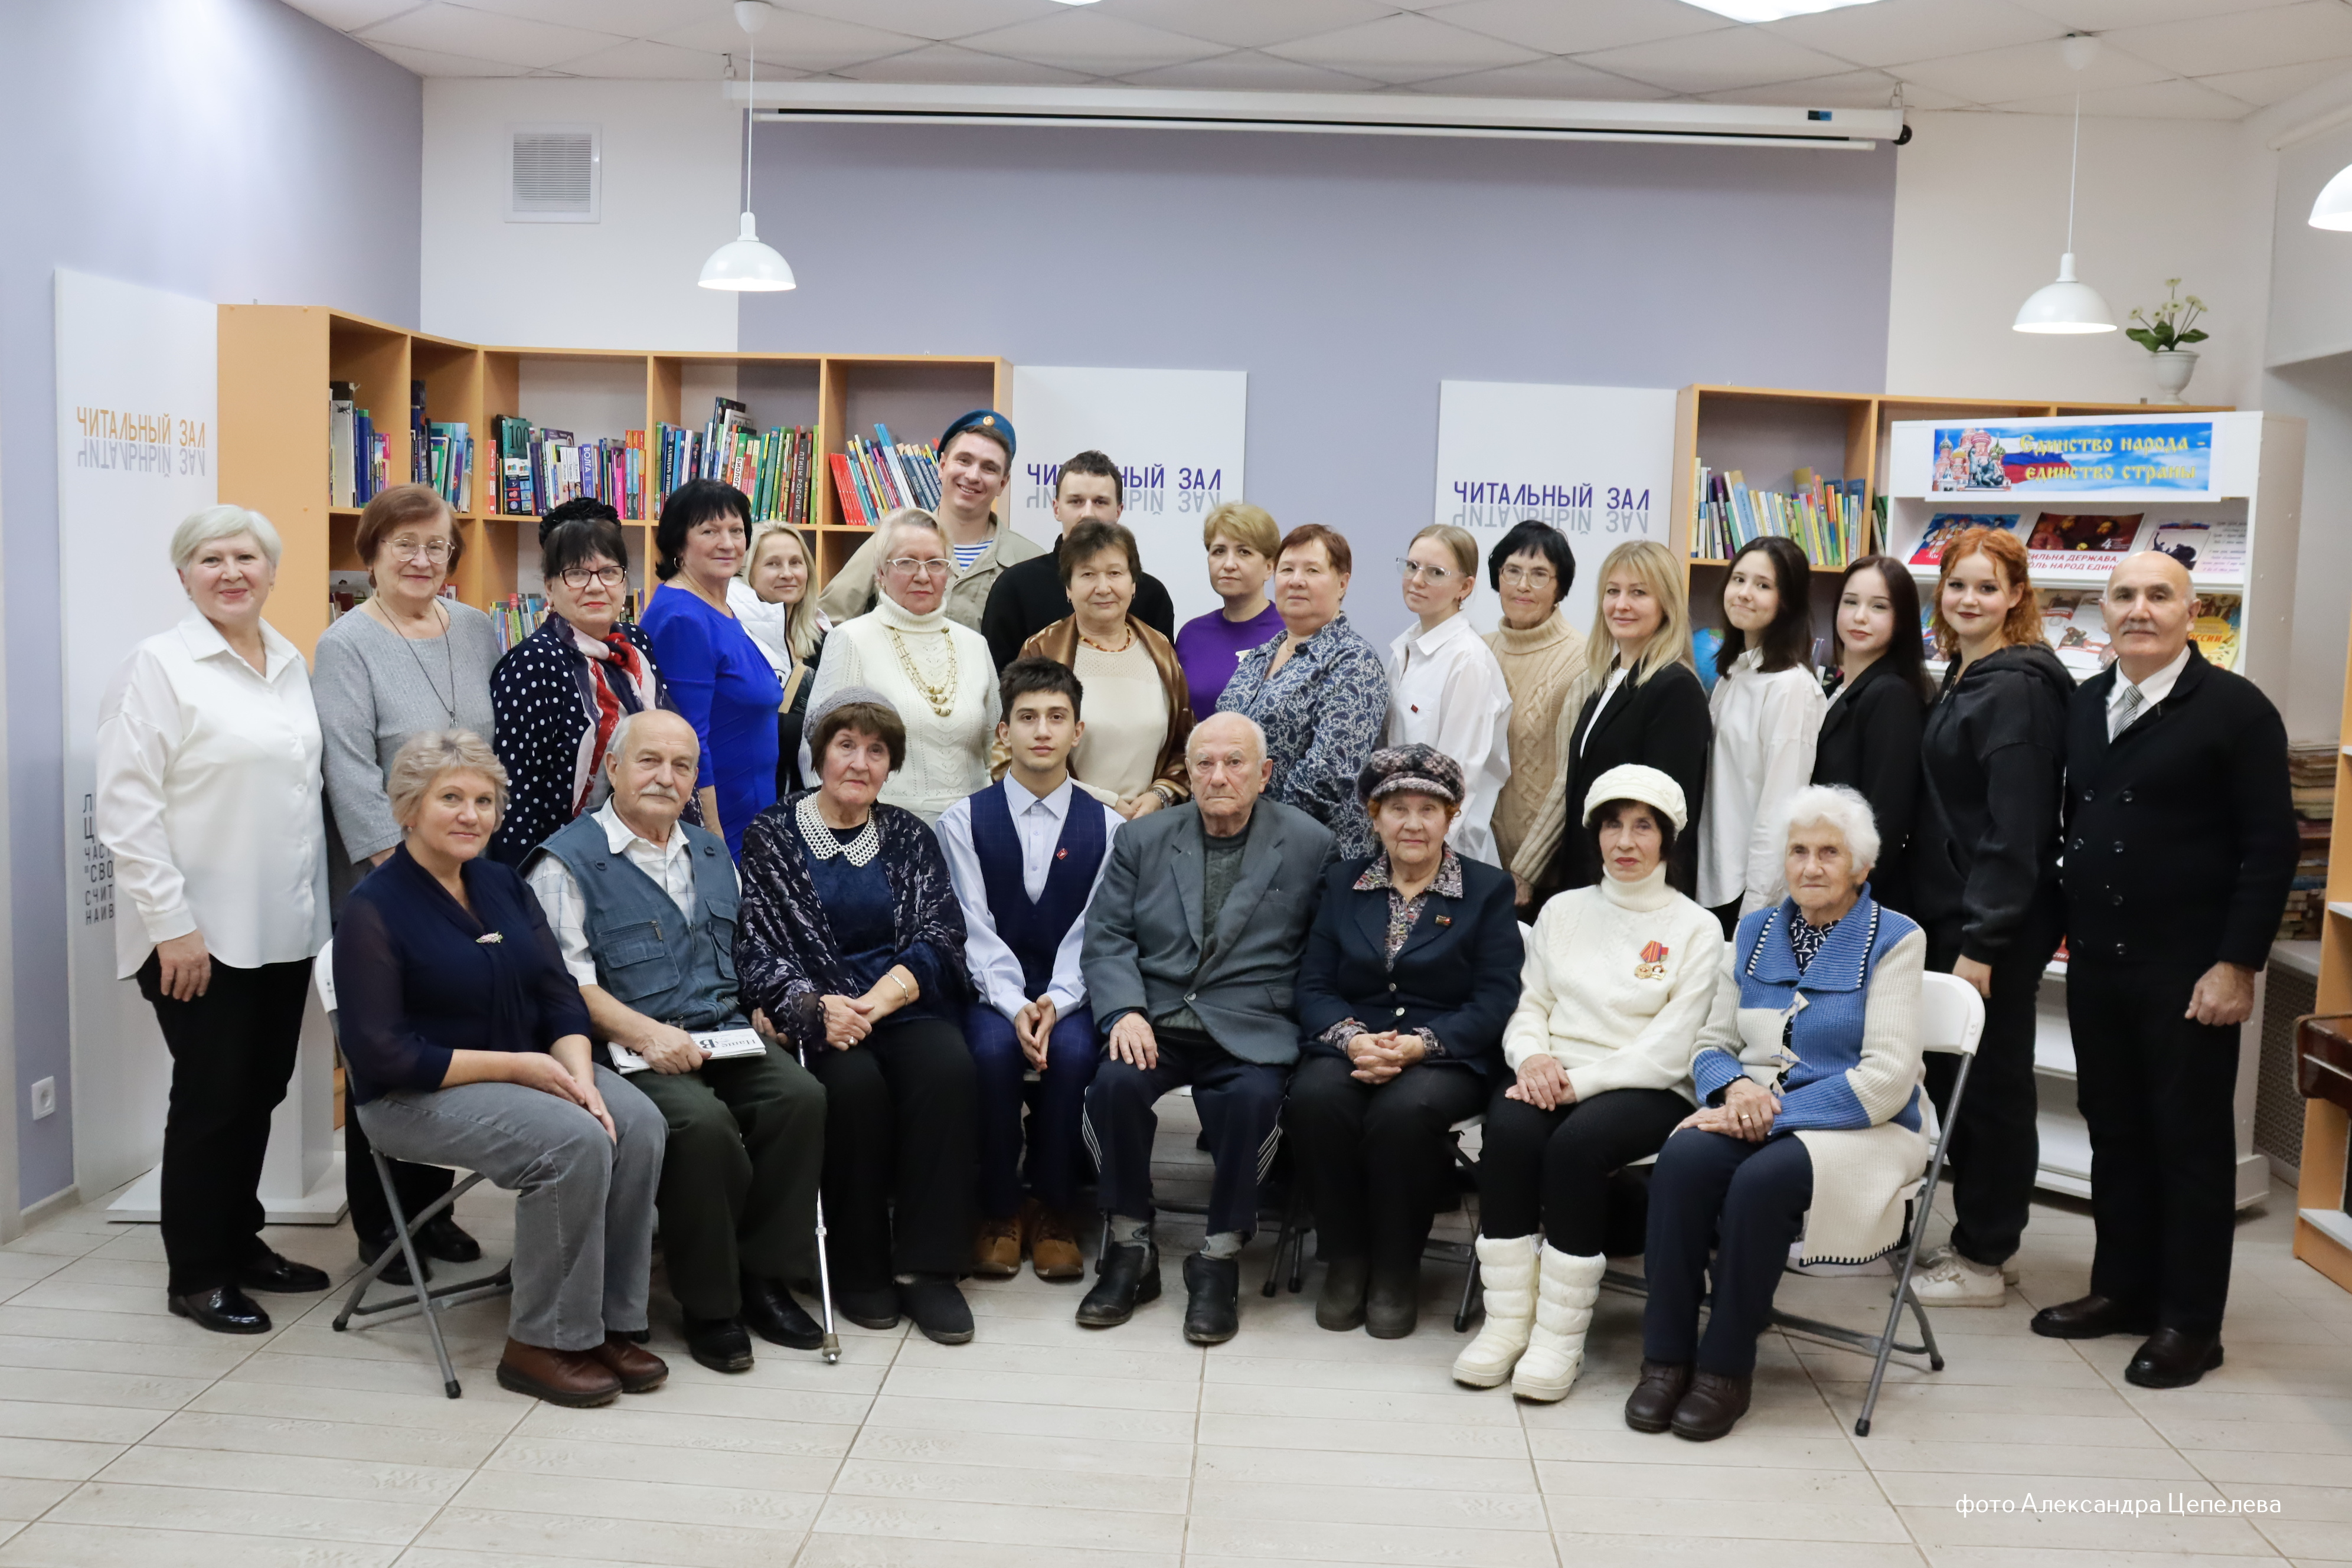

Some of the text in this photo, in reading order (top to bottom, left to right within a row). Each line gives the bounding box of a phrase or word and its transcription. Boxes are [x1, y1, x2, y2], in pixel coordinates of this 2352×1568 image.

[77, 406, 205, 448] ЧИТАЛЬНЫЙ ЗАЛ
[2020, 433, 2113, 455] Единство
[2121, 436, 2188, 456] народа
[1027, 463, 1221, 490] ЧИНЫЙ ЗАЛ
[2026, 462, 2196, 484] единство страны
[1455, 481, 1649, 511] ЧИТАЛЬНЫЙ ЗАЛ
[2067, 554, 2119, 563] ДЕРЖАВА,
